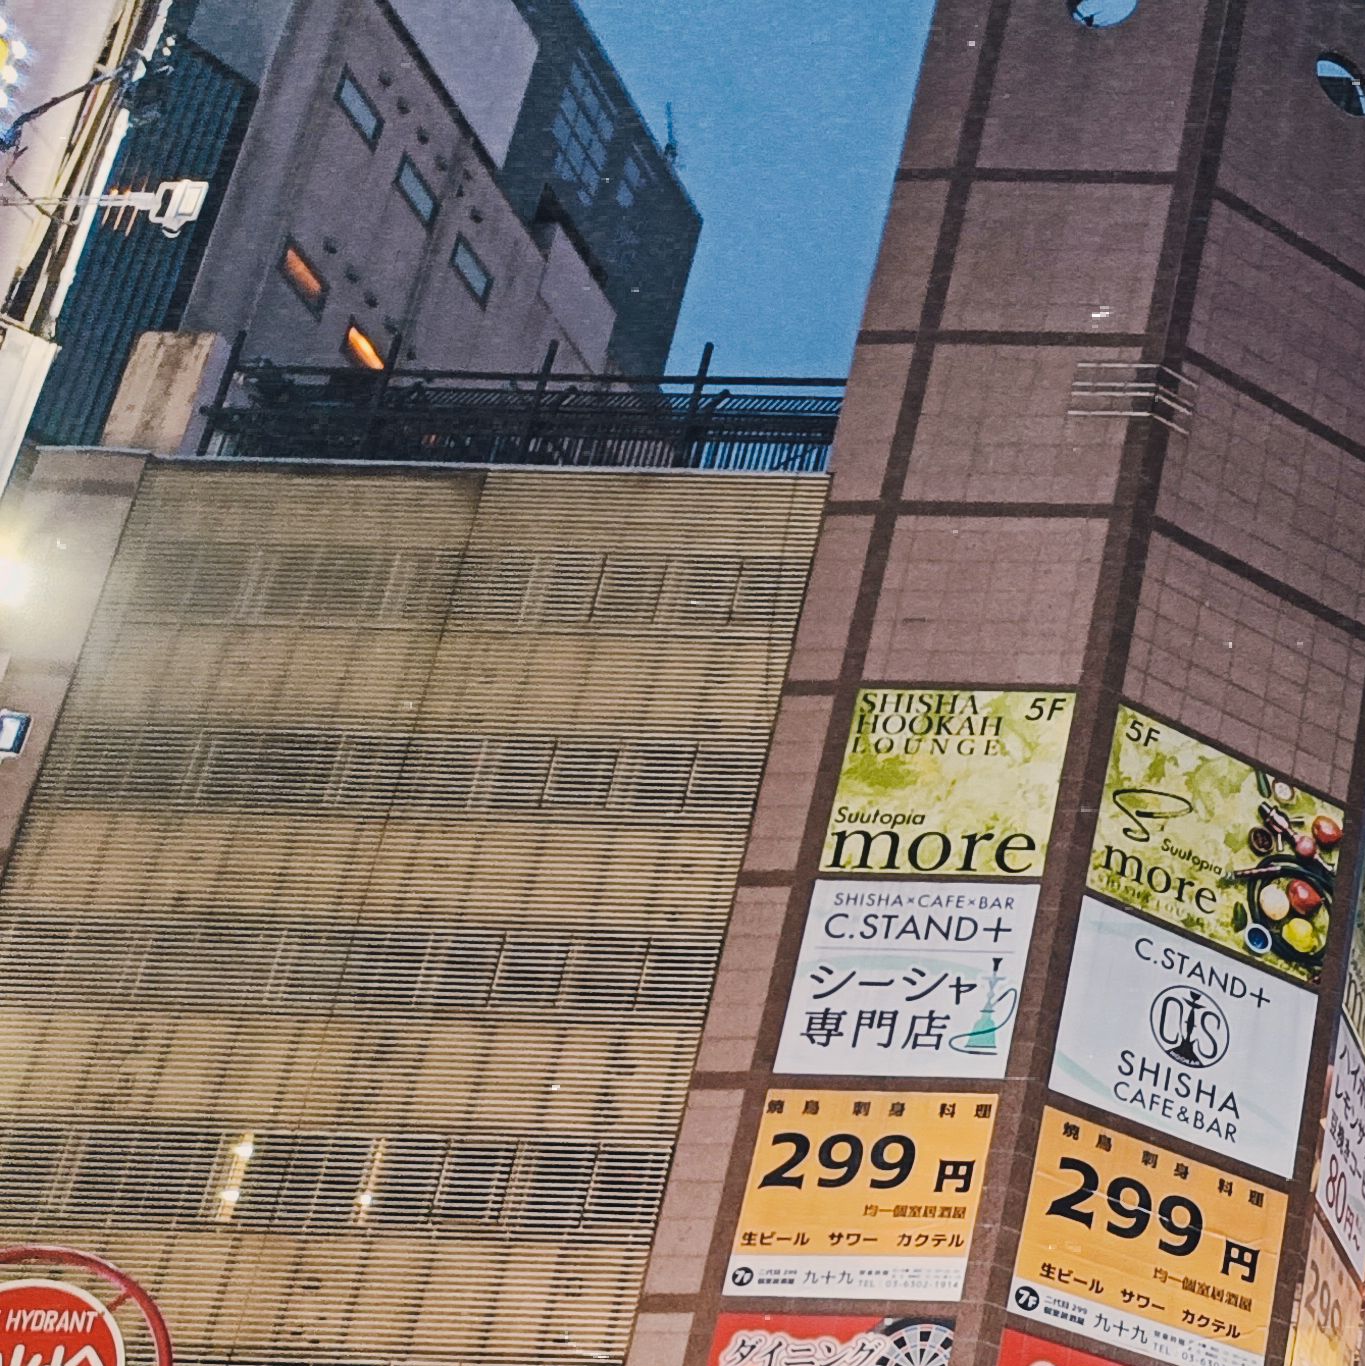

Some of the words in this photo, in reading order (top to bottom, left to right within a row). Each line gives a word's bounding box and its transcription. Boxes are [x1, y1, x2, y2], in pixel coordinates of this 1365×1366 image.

[860, 693, 978, 715] SHISHA
[1025, 697, 1067, 721] 5F
[856, 714, 1003, 737] HOOKAH
[1125, 719, 1161, 747] 5F
[852, 737, 1001, 756] LOUNGE
[834, 807, 926, 829] Suutopia
[825, 830, 1036, 873] more
[1161, 837, 1223, 875] Suutopia
[1100, 844, 1218, 915] more
[810, 965, 978, 1006] シーシャ
[800, 1007, 951, 1051] 専門店
[1117, 1049, 1241, 1120] SHISHA
[938, 1103, 992, 1119] 料理
[1112, 1081, 1238, 1144] CAFE&BAR
[758, 1132, 916, 1190] 299
[1046, 1156, 1203, 1257] 299
[1216, 1178, 1265, 1208] 料理
[740, 1231, 810, 1247] 生ビール
[828, 1232, 878, 1246] サワー
[896, 1233, 965, 1248] カクテル
[803, 1270, 853, 1285] 九十九
[1017, 1288, 1039, 1310] 7F
[1039, 1262, 1104, 1294] 生ビール
[1120, 1288, 1166, 1312] サワー
[1182, 1309, 1241, 1340] カクテル
[6, 1309, 98, 1333] HYDRANT
[1093, 1312, 1148, 1344] 九十九
